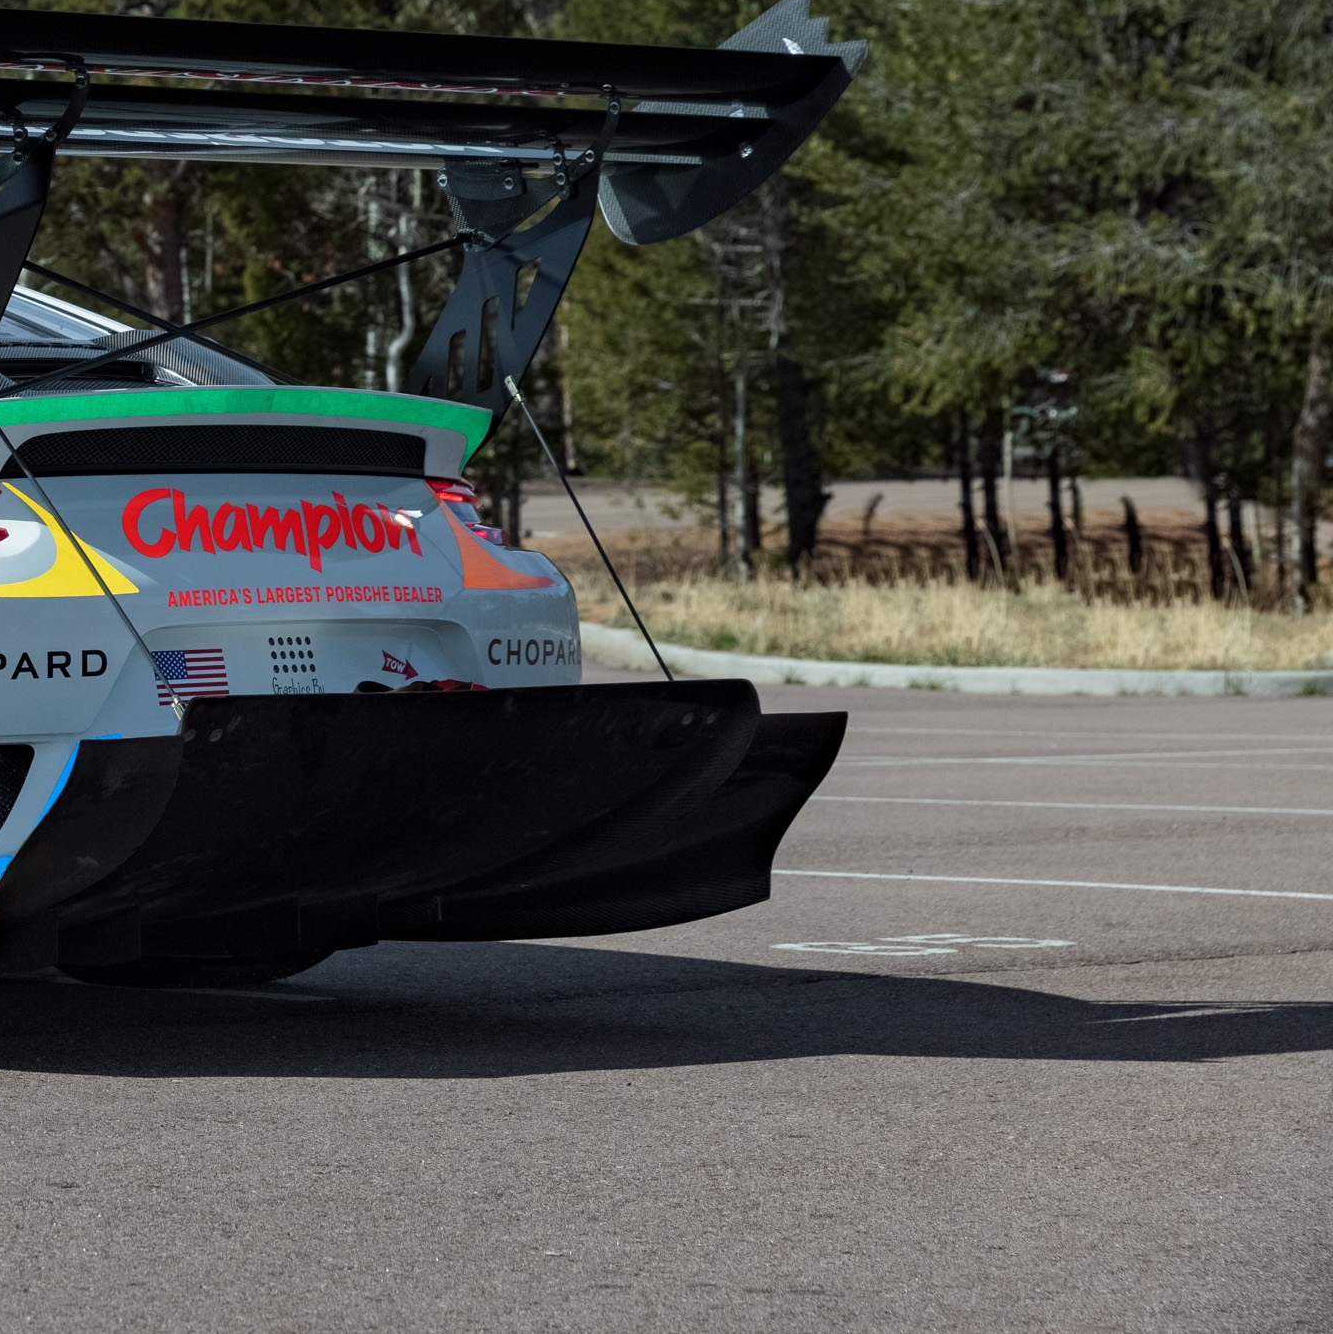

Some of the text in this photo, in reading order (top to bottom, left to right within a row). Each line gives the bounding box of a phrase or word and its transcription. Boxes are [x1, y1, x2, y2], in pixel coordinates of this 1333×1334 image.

[122, 488, 423, 573] Champion
[167, 585, 443, 608] AMERICA'S LARGEST PORSCHE DEALER
[385, 657, 406, 674] TOW
